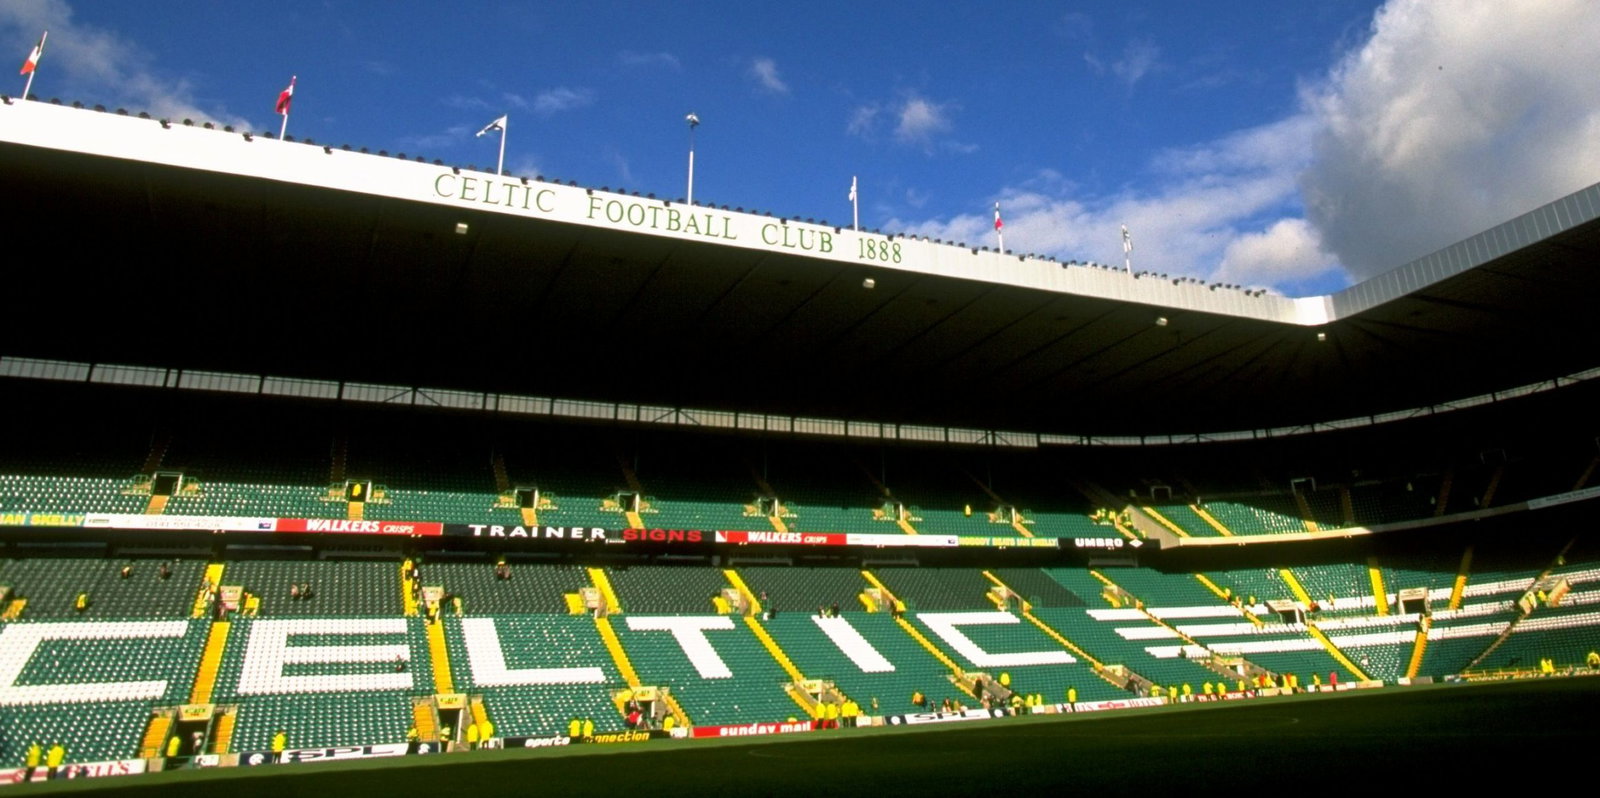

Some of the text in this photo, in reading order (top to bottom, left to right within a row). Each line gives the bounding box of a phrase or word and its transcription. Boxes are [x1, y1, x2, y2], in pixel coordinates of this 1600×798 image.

[434, 173, 903, 264] CELTIC FOOTBALL CLUB 1888
[30, 513, 84, 527] SKELLY
[306, 519, 414, 533] WALKERS CRISPS
[468, 524, 703, 542] TRAINER SIGNS
[748, 531, 802, 543] WALKERS
[1075, 538, 1124, 547] UMBRO
[914, 712, 981, 720] SPL
[720, 721, 811, 736] sunday mail
[524, 736, 570, 748] sports
[288, 746, 395, 763] SPL
